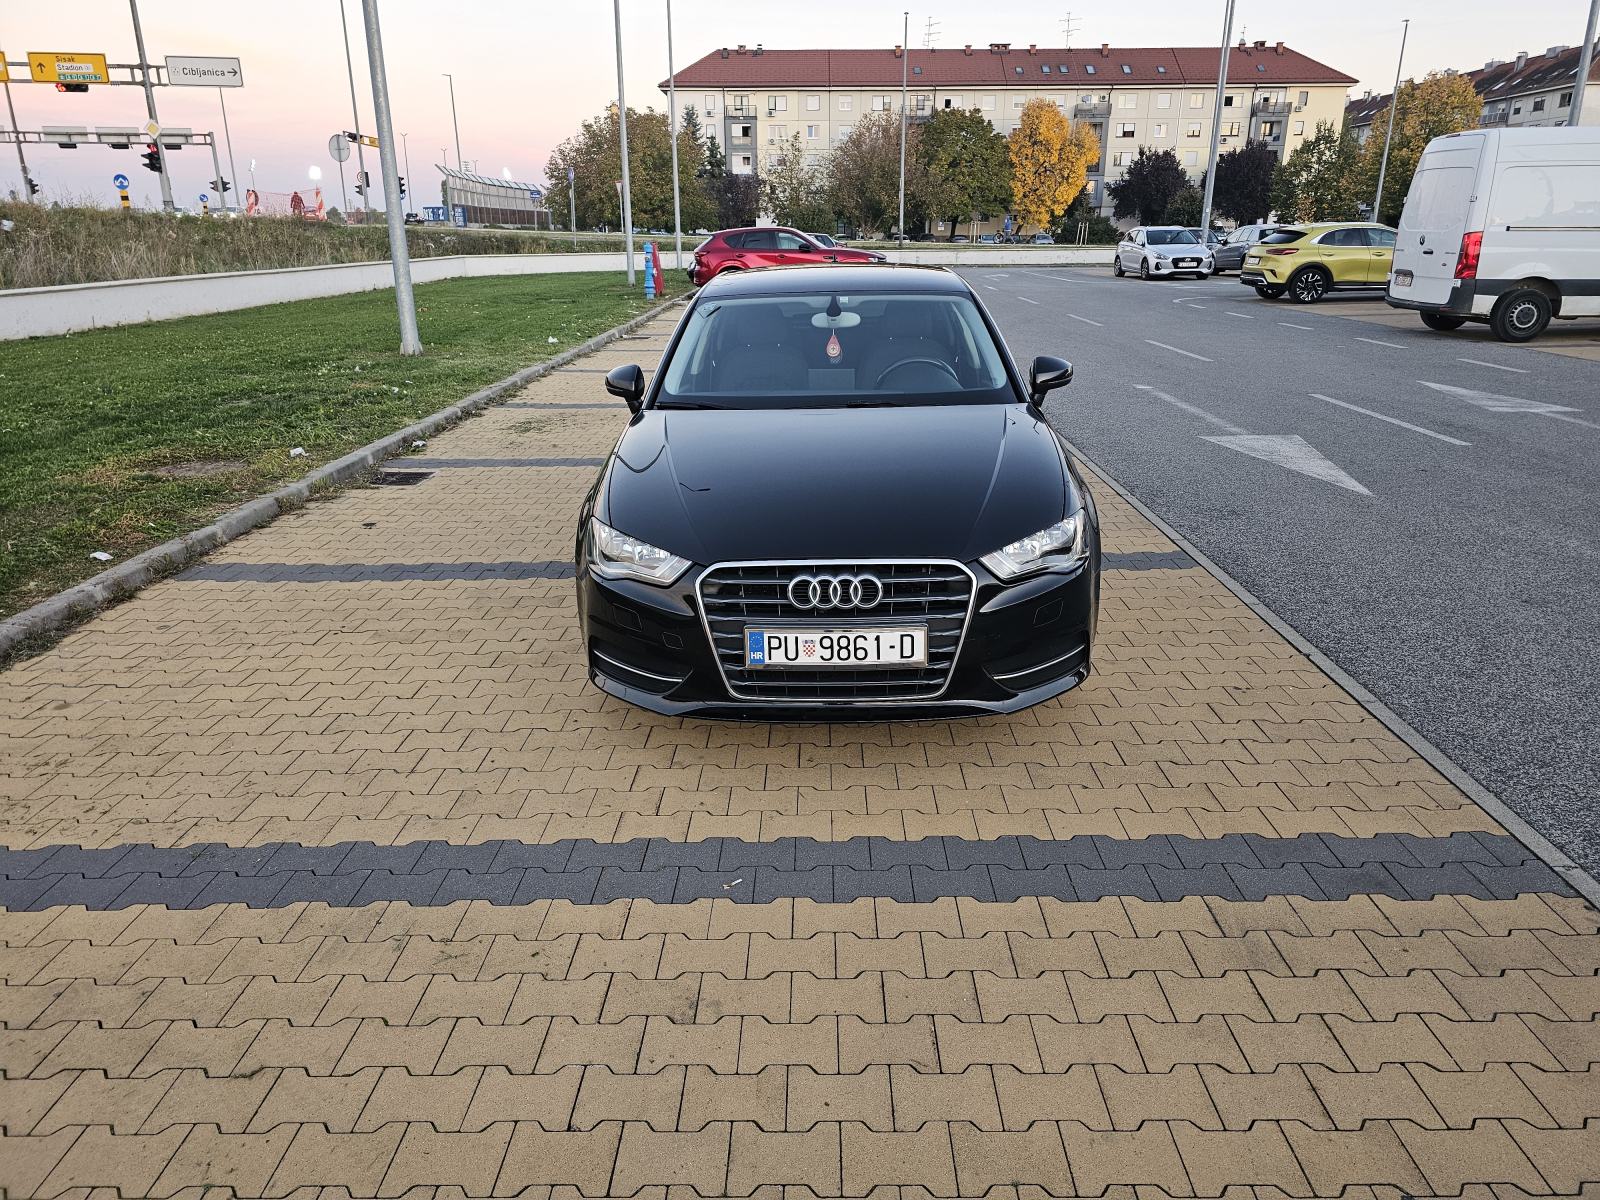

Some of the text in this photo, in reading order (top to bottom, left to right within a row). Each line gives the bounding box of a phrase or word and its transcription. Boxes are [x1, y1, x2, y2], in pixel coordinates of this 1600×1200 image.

[55, 55, 76, 63] Sisak
[56, 63, 83, 71] Stadion
[182, 67, 226, 77] Cibljanica
[767, 633, 915, 661] PU 9861-D
[750, 651, 764, 660] HR
